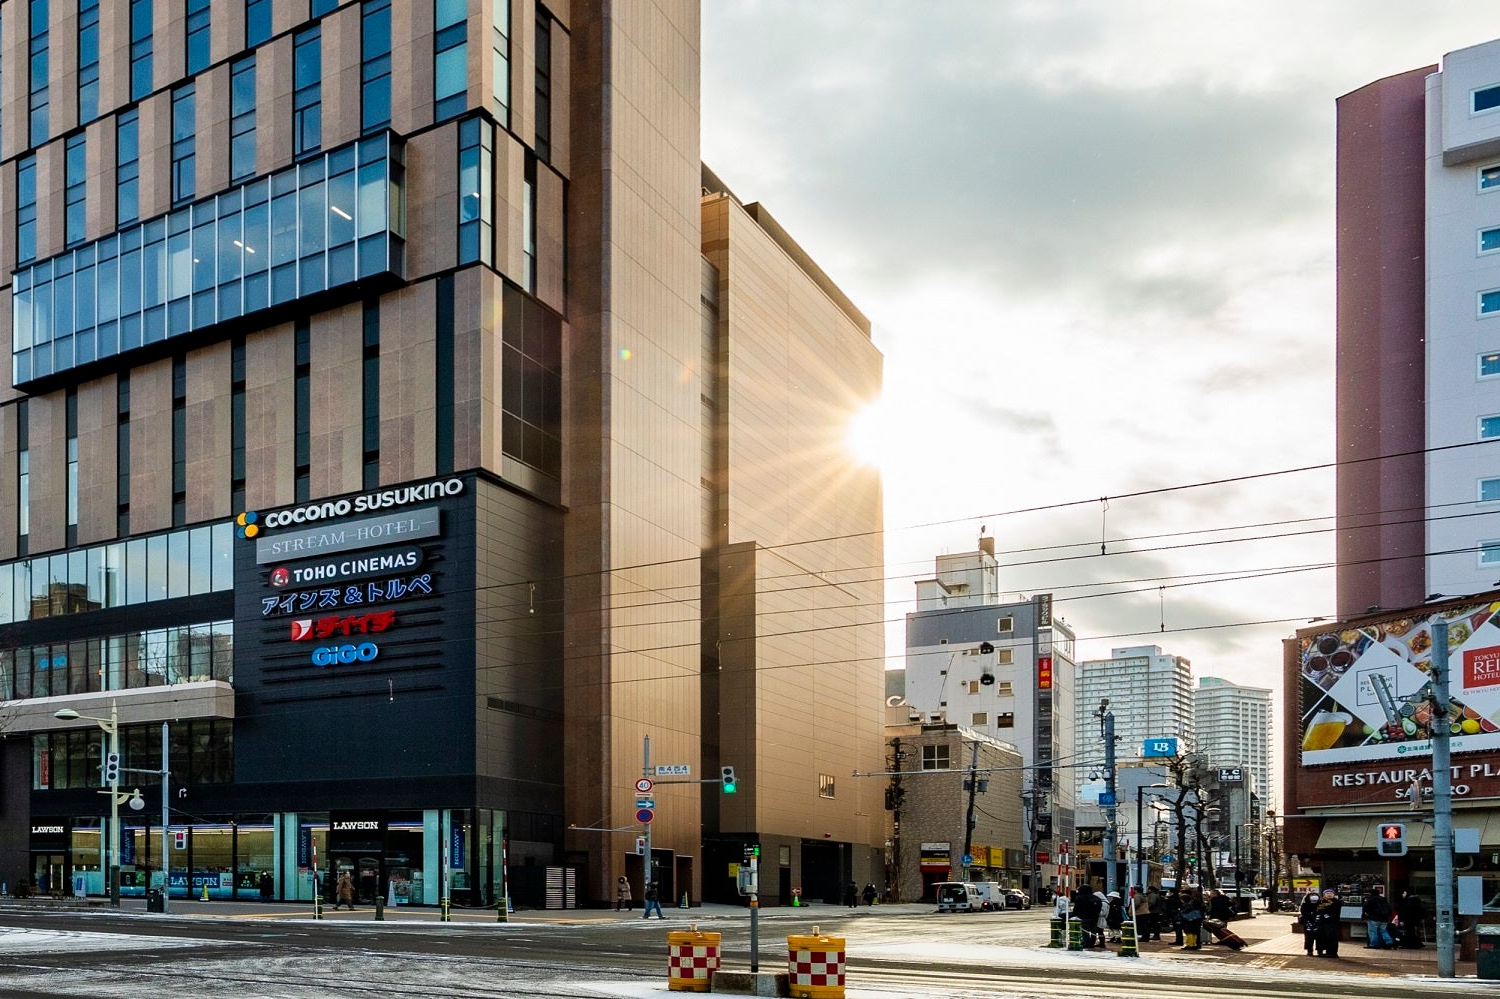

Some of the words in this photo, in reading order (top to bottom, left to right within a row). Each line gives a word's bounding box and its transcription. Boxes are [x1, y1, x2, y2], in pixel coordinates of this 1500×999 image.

[265, 499, 351, 528] COCONO
[354, 478, 464, 512] SUSUKINO
[272, 531, 346, 556] STREAM
[357, 518, 421, 541] HOTEL
[293, 563, 337, 583] TOHO
[340, 551, 417, 576] CINEMAS
[316, 610, 396, 638] ダイイチ
[311, 641, 379, 667] GiGO
[1473, 653, 1500, 661] TOKYU
[1332, 764, 1463, 787] RESTAURAT
[1470, 762, 1500, 778] PL
[31, 826, 64, 834] LAWSON
[333, 821, 379, 830] LAWSON
